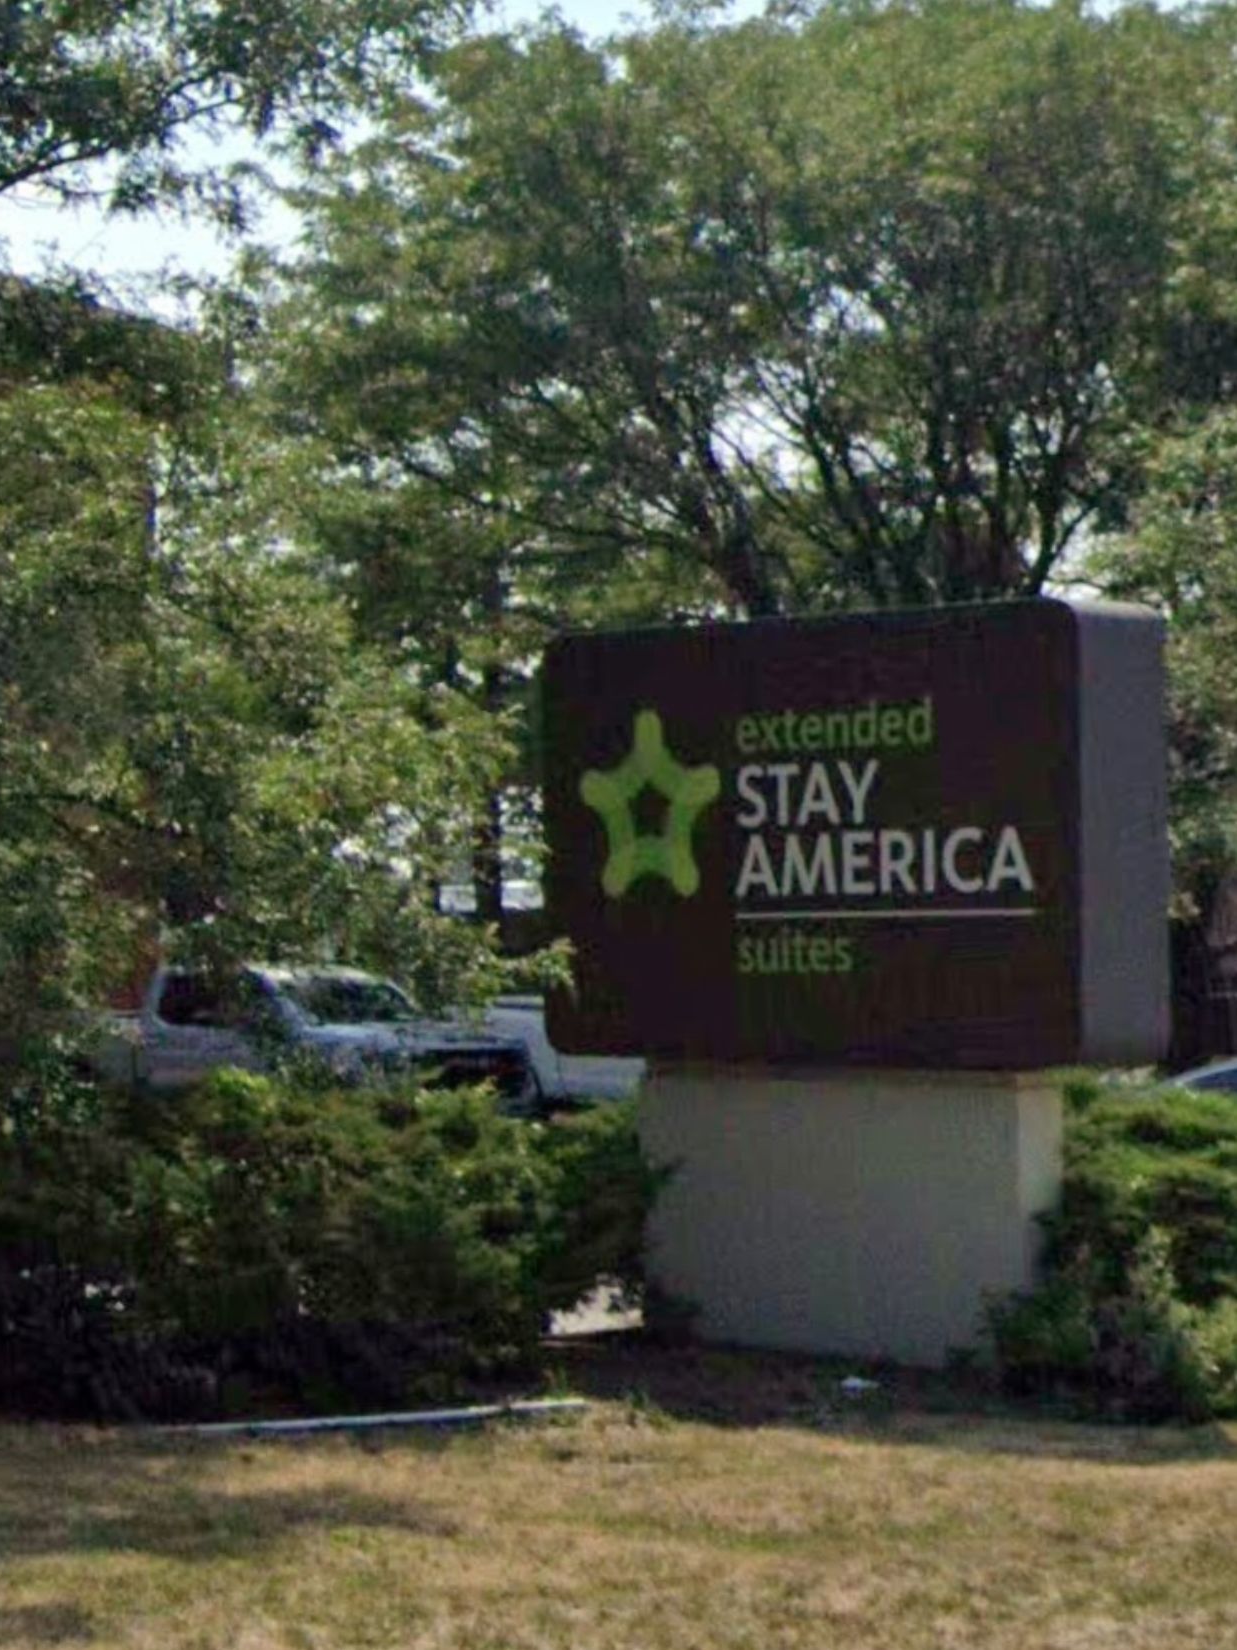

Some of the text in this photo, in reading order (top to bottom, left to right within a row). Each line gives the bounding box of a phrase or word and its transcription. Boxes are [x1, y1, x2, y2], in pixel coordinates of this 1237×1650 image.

[735, 696, 933, 751] extended
[735, 759, 878, 828] STAY
[735, 825, 1035, 897] AMERICA
[736, 929, 854, 974] suites
